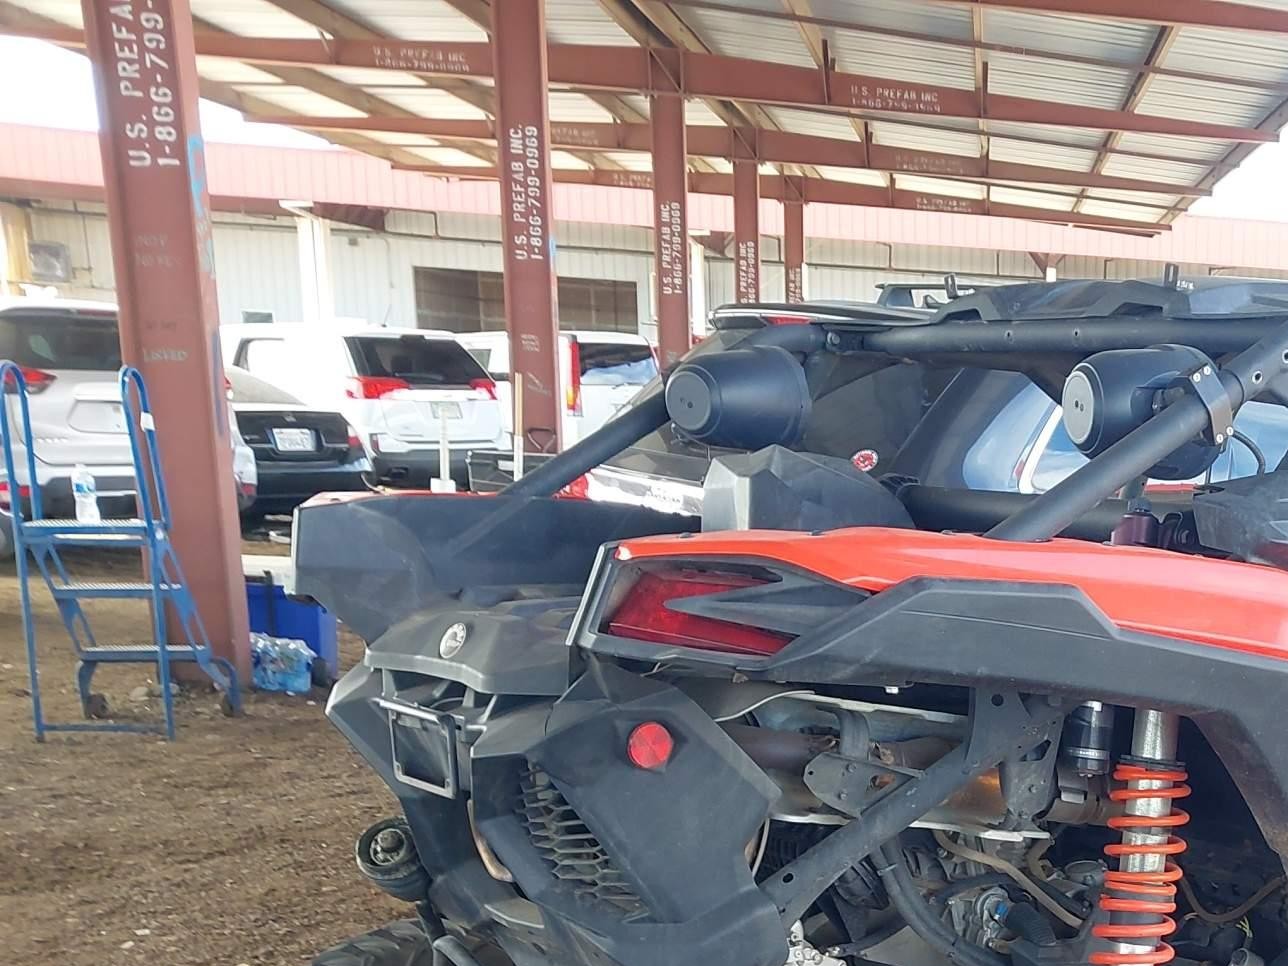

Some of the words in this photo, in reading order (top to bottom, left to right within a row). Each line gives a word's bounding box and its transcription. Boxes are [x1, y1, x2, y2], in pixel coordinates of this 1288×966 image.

[109, 0, 144, 97] PREFA
[125, 114, 151, 167] U.S.
[509, 124, 524, 154] INC.
[510, 161, 526, 222] PREFAB
[525, 125, 543, 259] 1-866-799-0969
[514, 231, 528, 260] U.S.
[661, 226, 671, 268] PREFAB
